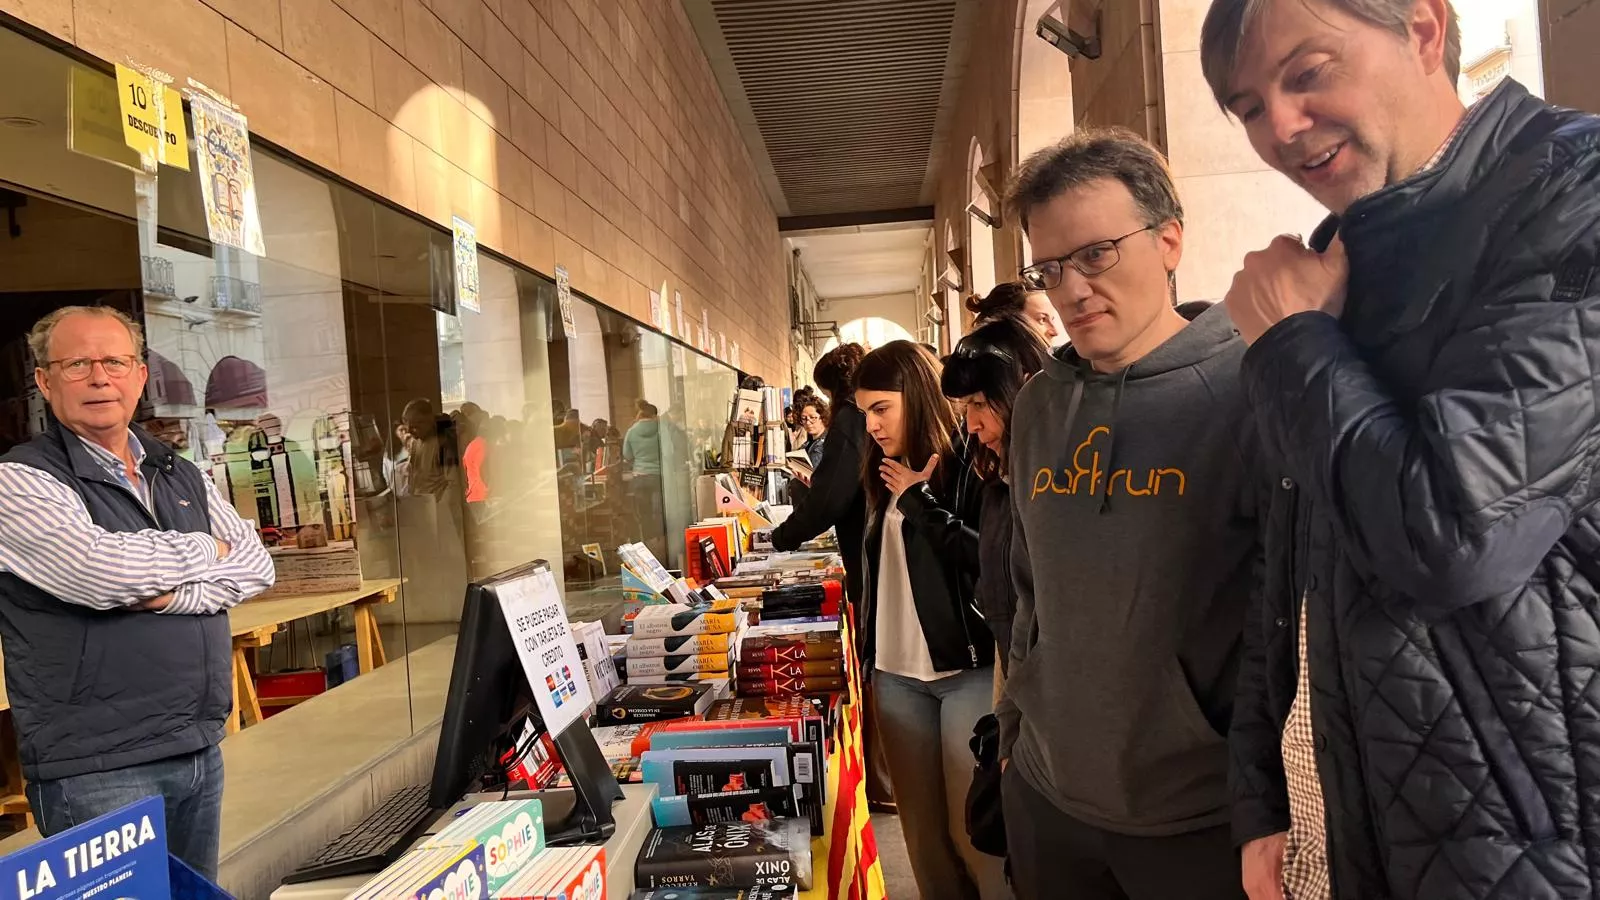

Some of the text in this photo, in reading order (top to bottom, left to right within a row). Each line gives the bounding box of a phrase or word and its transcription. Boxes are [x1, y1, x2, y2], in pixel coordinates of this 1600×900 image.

[128, 83, 147, 110] 10
[127, 114, 177, 146] DESCUETO
[1031, 427, 1185, 500] parkrun
[516, 604, 561, 632] SE PUEDE PAGAR
[524, 622, 566, 653] CON TARJETA DE
[541, 645, 564, 667] CREDITO
[794, 649, 807, 659] LA
[790, 665, 802, 676] LA
[794, 681, 806, 691] LA
[489, 824, 532, 865] SOPHIE
[692, 830, 712, 852] ALAS
[17, 815, 156, 900] LA TIERRA
[755, 860, 790, 878] ÓNIX
[82, 882, 109, 900] NUESTRO
[108, 869, 134, 887] PLANETA
[661, 875, 695, 883] YARROS
